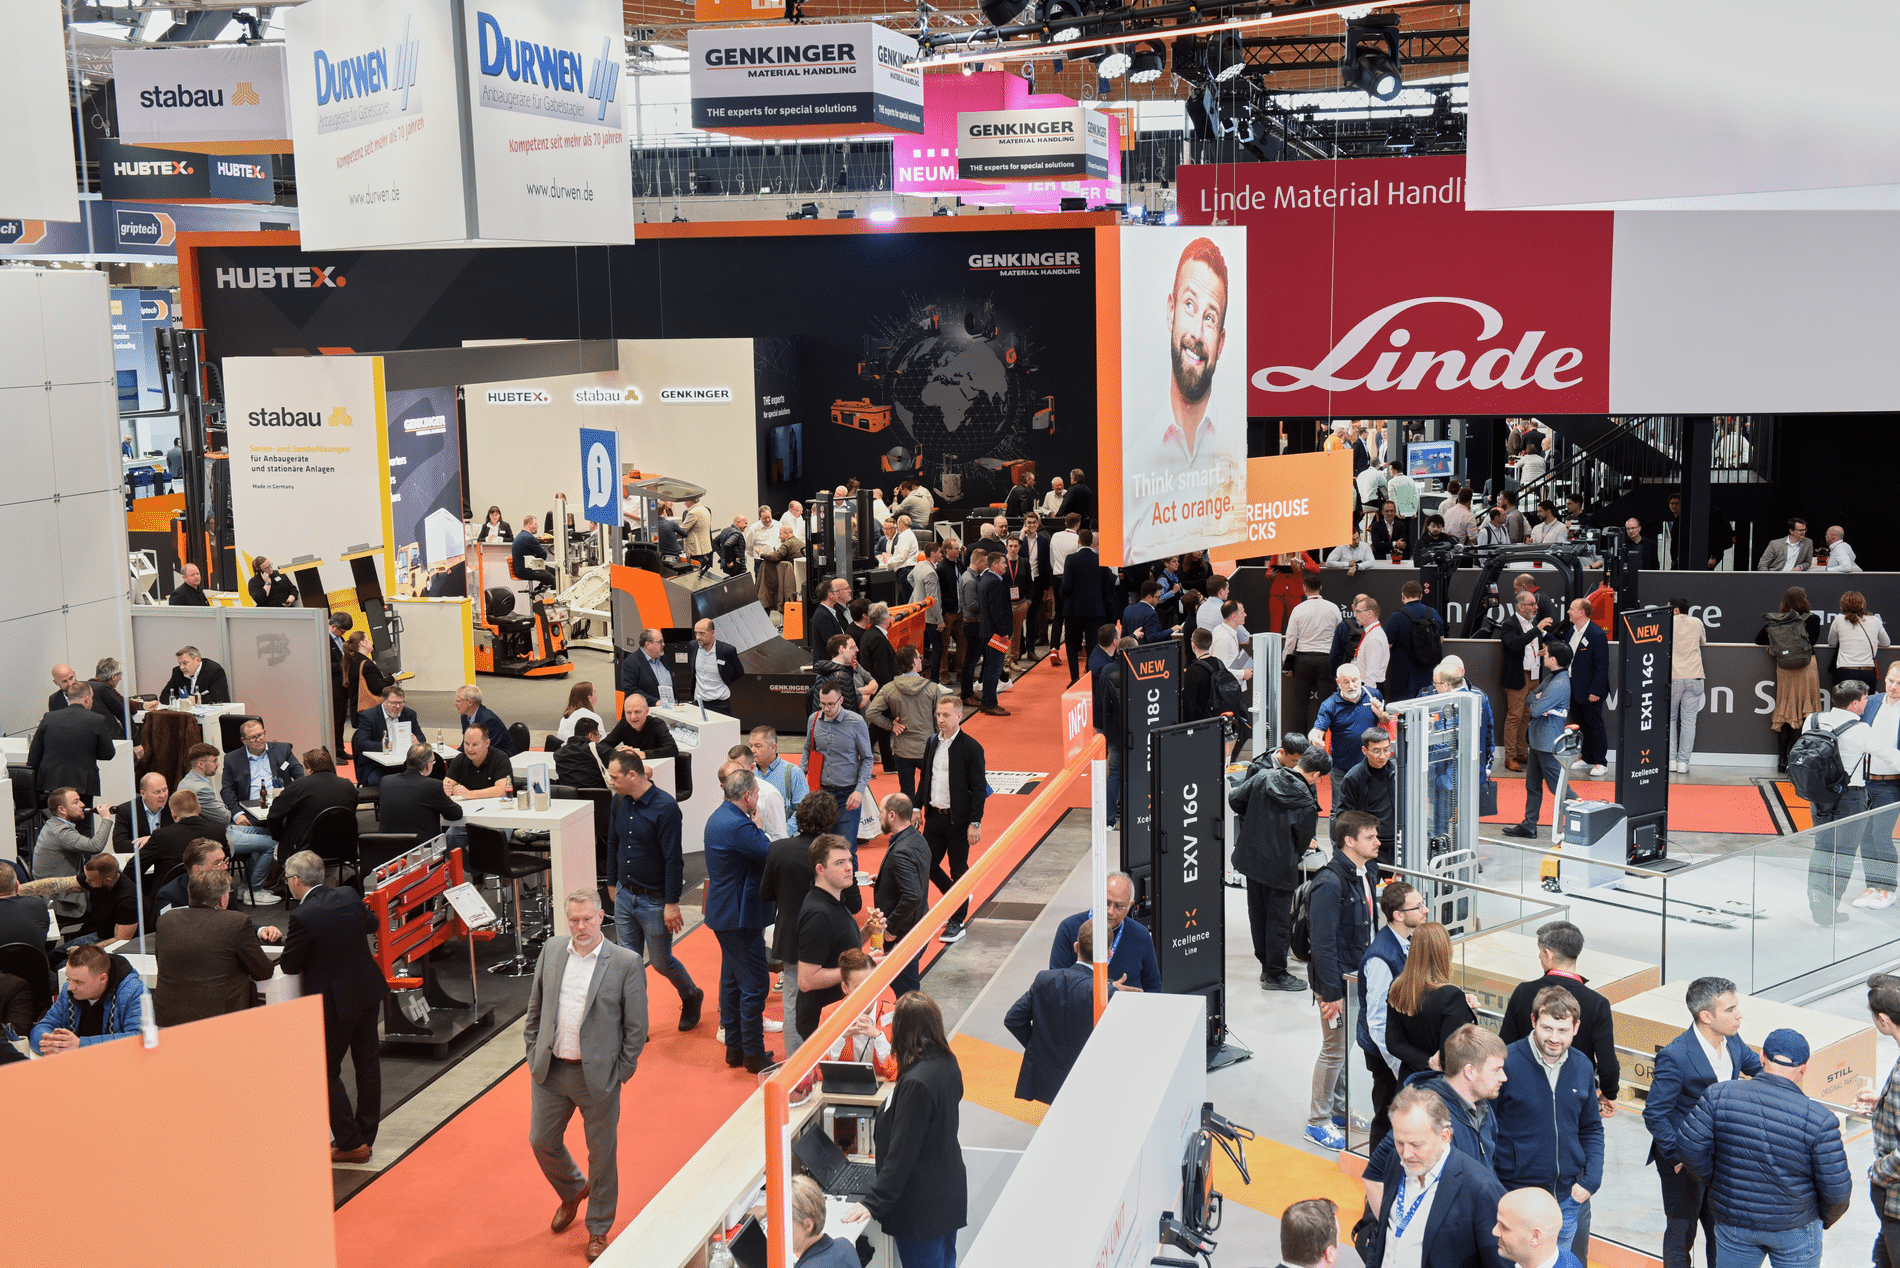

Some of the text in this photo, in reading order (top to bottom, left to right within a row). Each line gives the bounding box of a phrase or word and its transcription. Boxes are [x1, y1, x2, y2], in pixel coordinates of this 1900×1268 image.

[477, 10, 583, 94] DURWEN
[705, 43, 856, 66] GENKINGER
[314, 47, 388, 106] DURWEN
[748, 66, 856, 78] MATERIAL HANDLING
[140, 84, 224, 108] stabau
[483, 85, 585, 118] Anbaugeräte für Gabelstapler
[707, 104, 857, 118] THE experts for special solutions
[969, 121, 1074, 137] GENKINGER
[336, 149, 364, 169] Kompetenz
[364, 140, 374, 156] seit
[374, 133, 388, 151] mehr
[509, 130, 623, 155] Kompetenz seit mehr als 70 Jahren
[113, 161, 194, 176] HUBTEX.
[217, 161, 265, 179] HUBTEX.
[900, 166, 958, 181] NEUM
[984, 164, 1008, 172] experts
[1020, 162, 1043, 171] special
[1045, 161, 1075, 169] solutions
[349, 180, 400, 205] www.durwen.de
[526, 177, 593, 201] www.durwen.de
[1201, 177, 1467, 212] Linde Material Handli
[120, 222, 158, 236] griptech
[968, 251, 1080, 267] GENKINGER
[216, 266, 346, 288] HUBTEX.
[1251, 296, 1583, 392] Linde
[488, 392, 548, 402] HUBTEX.
[576, 390, 620, 402] stabau
[661, 390, 729, 399] GENKINGER
[248, 407, 322, 427] stabau
[250, 445, 350, 454] Serien- und Sonderlösungen
[250, 455, 309, 464] für Anbaugeräte
[267, 465, 303, 473] stationäre
[306, 465, 335, 474] Anlagen
[1132, 464, 1225, 499] Think smart.
[1152, 495, 1234, 527] Act orange.
[1246, 497, 1309, 521] REHOUSE
[1637, 624, 1660, 638] NEW
[1139, 659, 1166, 675] NEW
[1641, 652, 1654, 731] EXH 14C
[1147, 688, 1160, 725] 18C
[1068, 698, 1088, 741] INFO
[1631, 767, 1659, 779] Xcellence
[1639, 777, 1650, 785] Line
[1183, 783, 1199, 883] EXV 16C
[1172, 931, 1210, 948] Xcellence
[1184, 946, 1198, 956] Line
[1827, 1066, 1853, 1083] STILL
